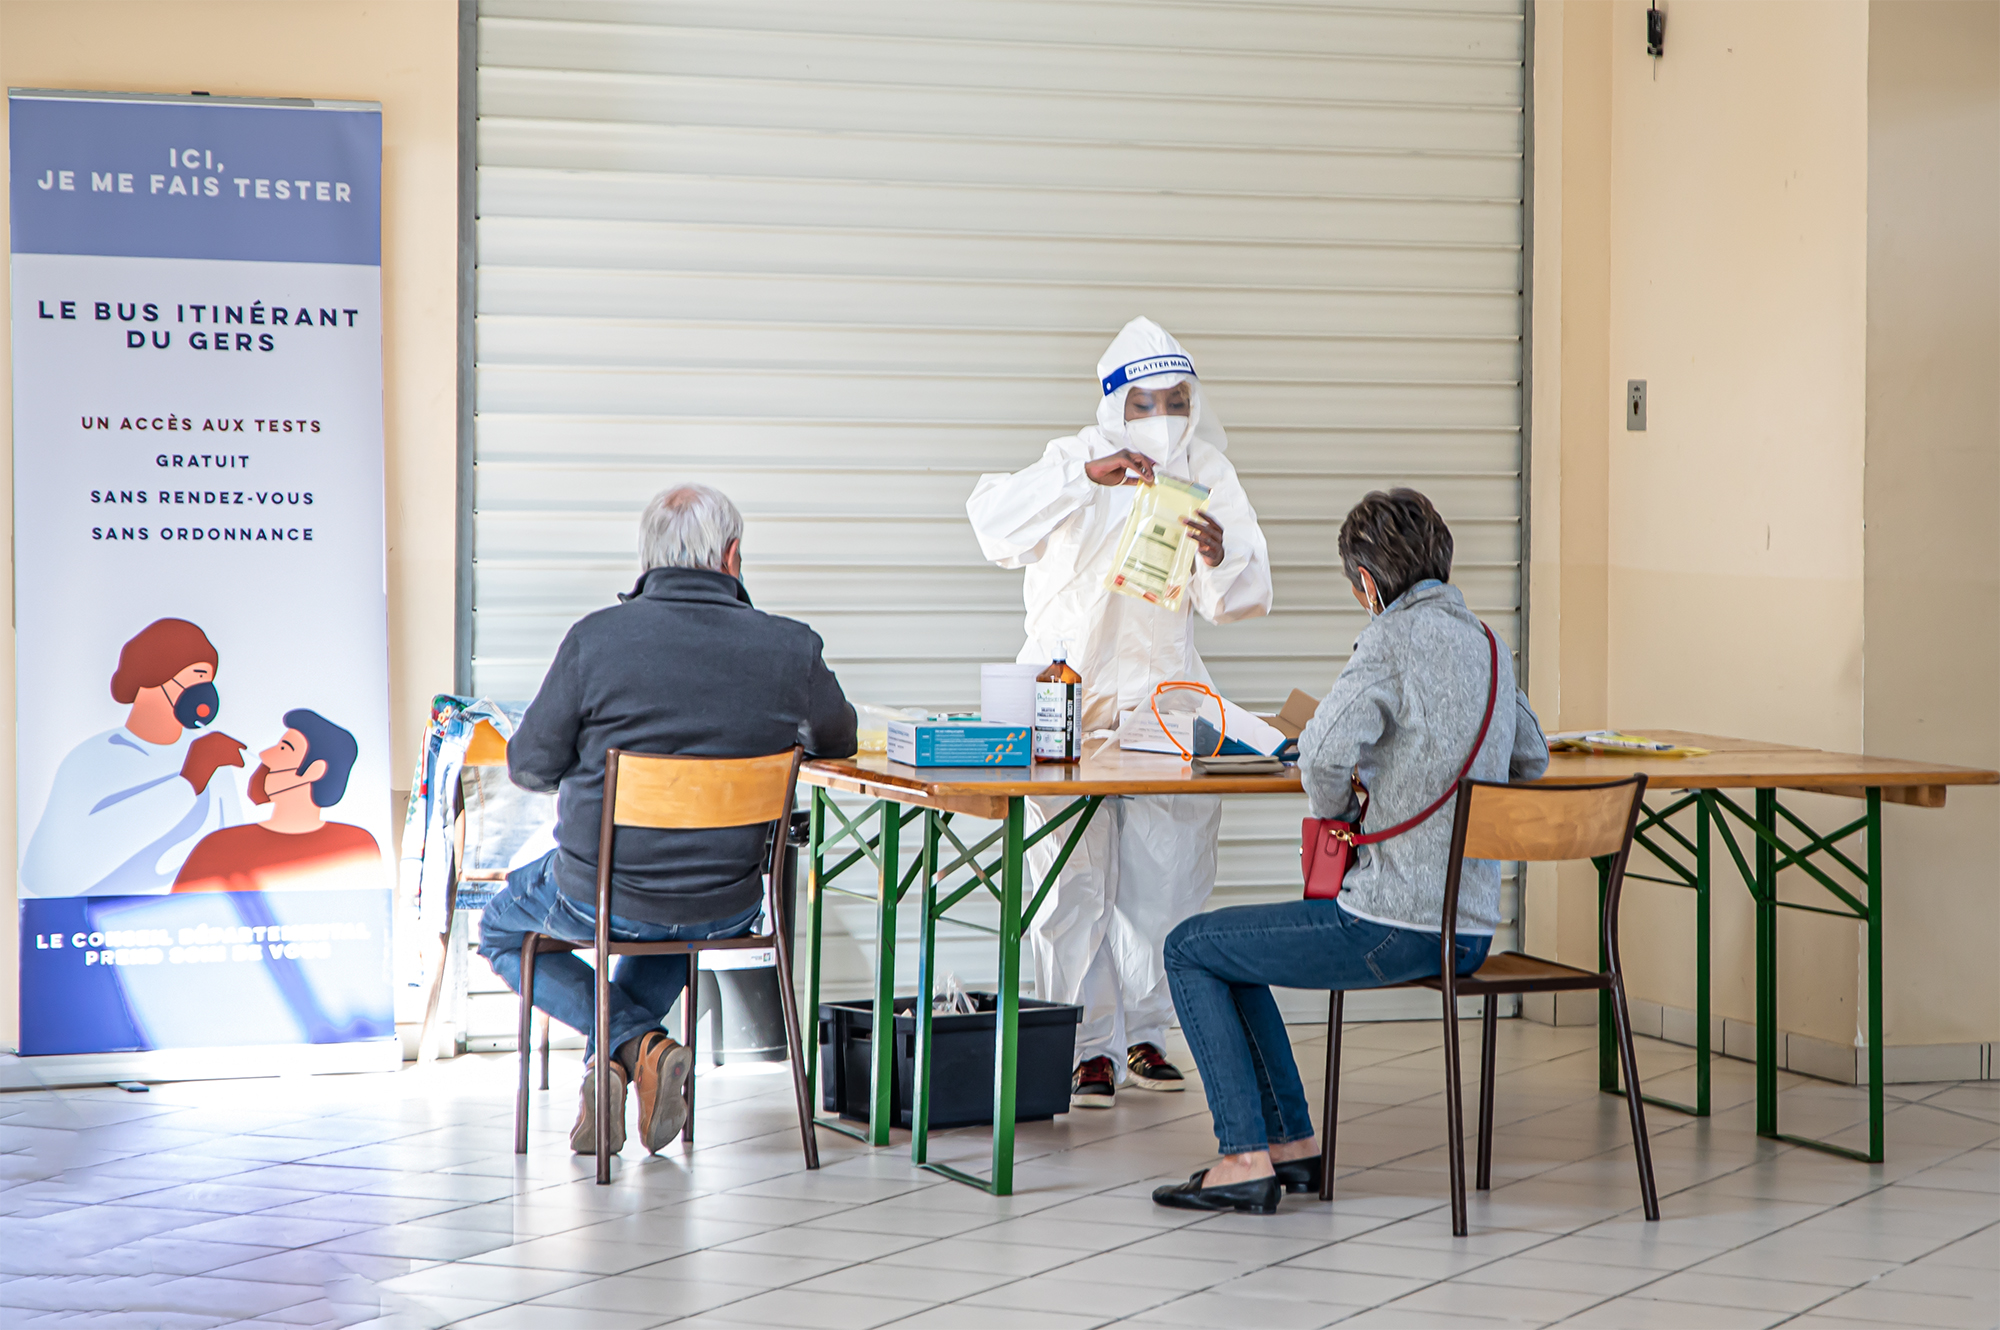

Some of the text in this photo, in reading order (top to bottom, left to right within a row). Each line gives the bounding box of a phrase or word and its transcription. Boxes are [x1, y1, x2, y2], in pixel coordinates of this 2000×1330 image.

[169, 148, 224, 173] ICI,
[37, 170, 351, 202] JE ME FAIS TESTER
[38, 299, 359, 328] LE BUS ITINÉRANT
[126, 330, 274, 352] DU GERS
[1129, 360, 1168, 375] SPLATTER
[81, 412, 321, 433] UN ACCÈS AUX TESTS
[155, 454, 250, 468] GRATUIT
[90, 490, 314, 505] SANS RENDEZ-VOUS
[91, 527, 313, 541] SANS ORDONNANCE
[36, 933, 64, 949] LE
